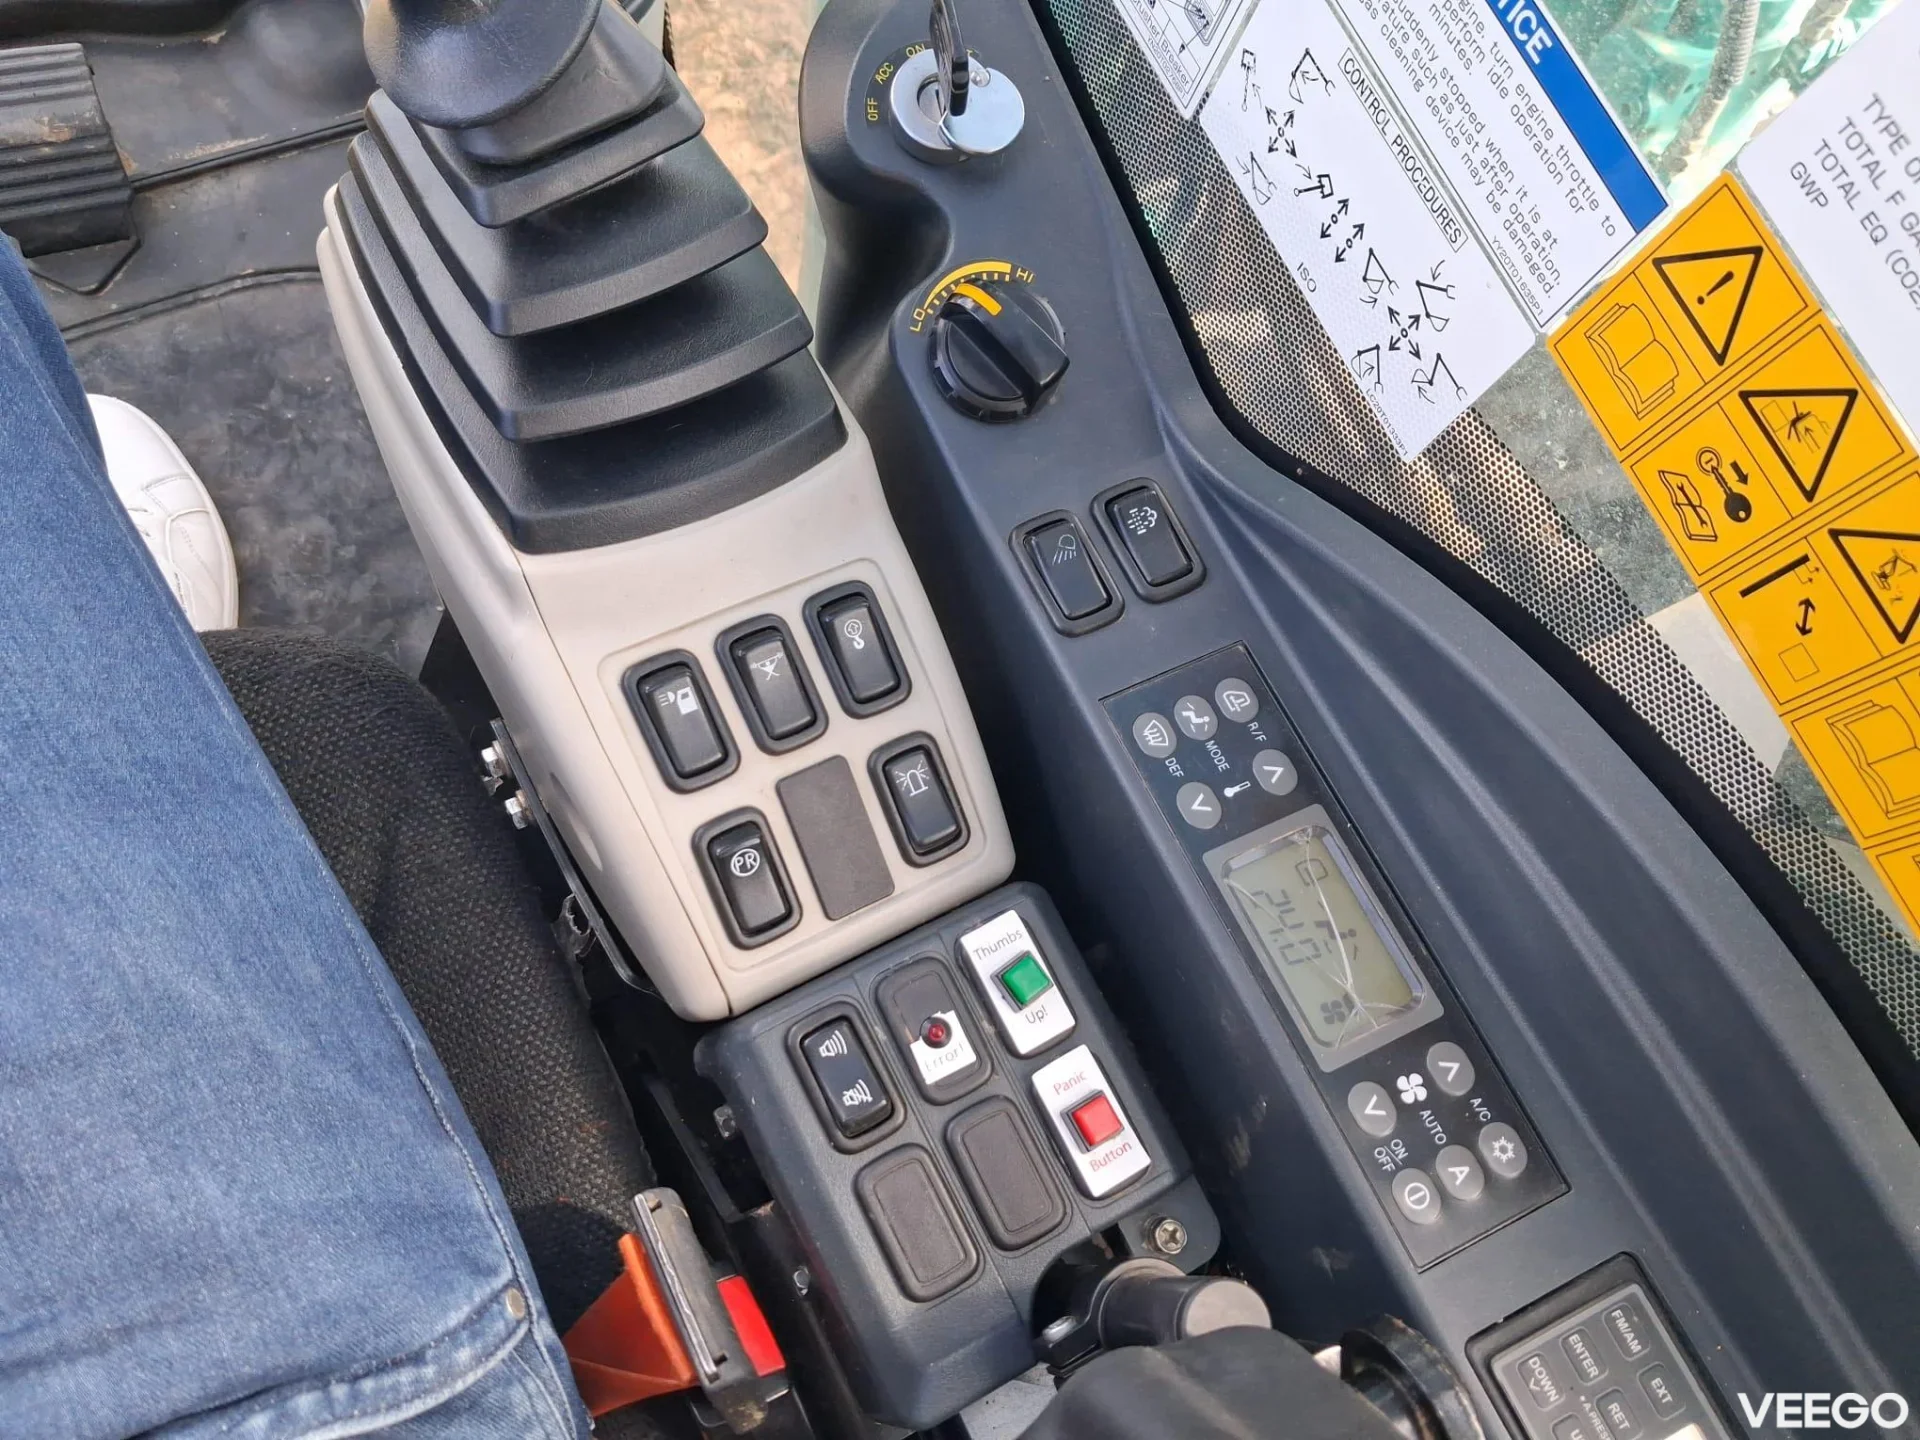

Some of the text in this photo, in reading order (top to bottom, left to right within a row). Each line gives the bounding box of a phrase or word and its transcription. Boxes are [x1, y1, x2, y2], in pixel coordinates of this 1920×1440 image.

[1133, 0, 1160, 37] rusher
[1497, 0, 1553, 65] ICE
[905, 43, 926, 59] ON
[1428, 3, 1473, 76] minutes.
[874, 62, 894, 85] ACC
[1160, 38, 1190, 88] Breaker
[867, 97, 879, 121] OFF
[1411, 48, 1438, 89] such
[1439, 92, 1455, 115] as
[1454, 116, 1480, 154] just
[1480, 157, 1509, 197] after
[1441, 0, 1585, 214] perform idle operation for
[1862, 92, 1910, 156] TYPE
[1343, 57, 1464, 246] CONTROL PROCEDURES
[1489, 41, 1514, 80] turn
[1515, 83, 1554, 142] engine
[1555, 144, 1600, 212] throttle
[1600, 215, 1616, 237] to
[1380, 23, 1425, 93] cleaning
[1425, 95, 1460, 149] device
[1460, 152, 1486, 187] may
[1485, 189, 1502, 214] be
[1502, 218, 1555, 299] damaged.
[1439, 67, 1486, 135] stopped
[1485, 137, 1515, 184] when
[1515, 184, 1528, 204] it
[1527, 203, 1541, 224] is
[1542, 229, 1558, 250] at
[1790, 161, 1829, 208] GWP
[1814, 138, 1861, 212] TOTAL
[1859, 210, 1888, 246] EQ
[1837, 116, 1920, 252] TOTAL F GA
[1016, 267, 1036, 284] HI
[1296, 261, 1317, 293] ISO
[909, 307, 926, 333] LO
[1247, 721, 1267, 742] R/F
[1164, 756, 1185, 779] DEF
[1204, 739, 1230, 773] MODE
[972, 930, 1023, 961] Thumbs
[1025, 1005, 1048, 1024] Up!
[1053, 1069, 1087, 1096] Panic
[1419, 1108, 1447, 1145] AUTO
[1469, 1096, 1492, 1122] A/C
[1089, 1141, 1133, 1172] Button
[1373, 1146, 1395, 1173] OFF
[1389, 1138, 1410, 1160] ON
[1611, 1308, 1642, 1355] FM/AM
[1569, 1332, 1600, 1381] ENTER
[1528, 1356, 1560, 1403] DOWN
[1650, 1376, 1673, 1405] EXT
[1582, 1402, 1611, 1440] A.PRES
[1607, 1401, 1631, 1430] RET
[1570, 1428, 1585, 1440] U
